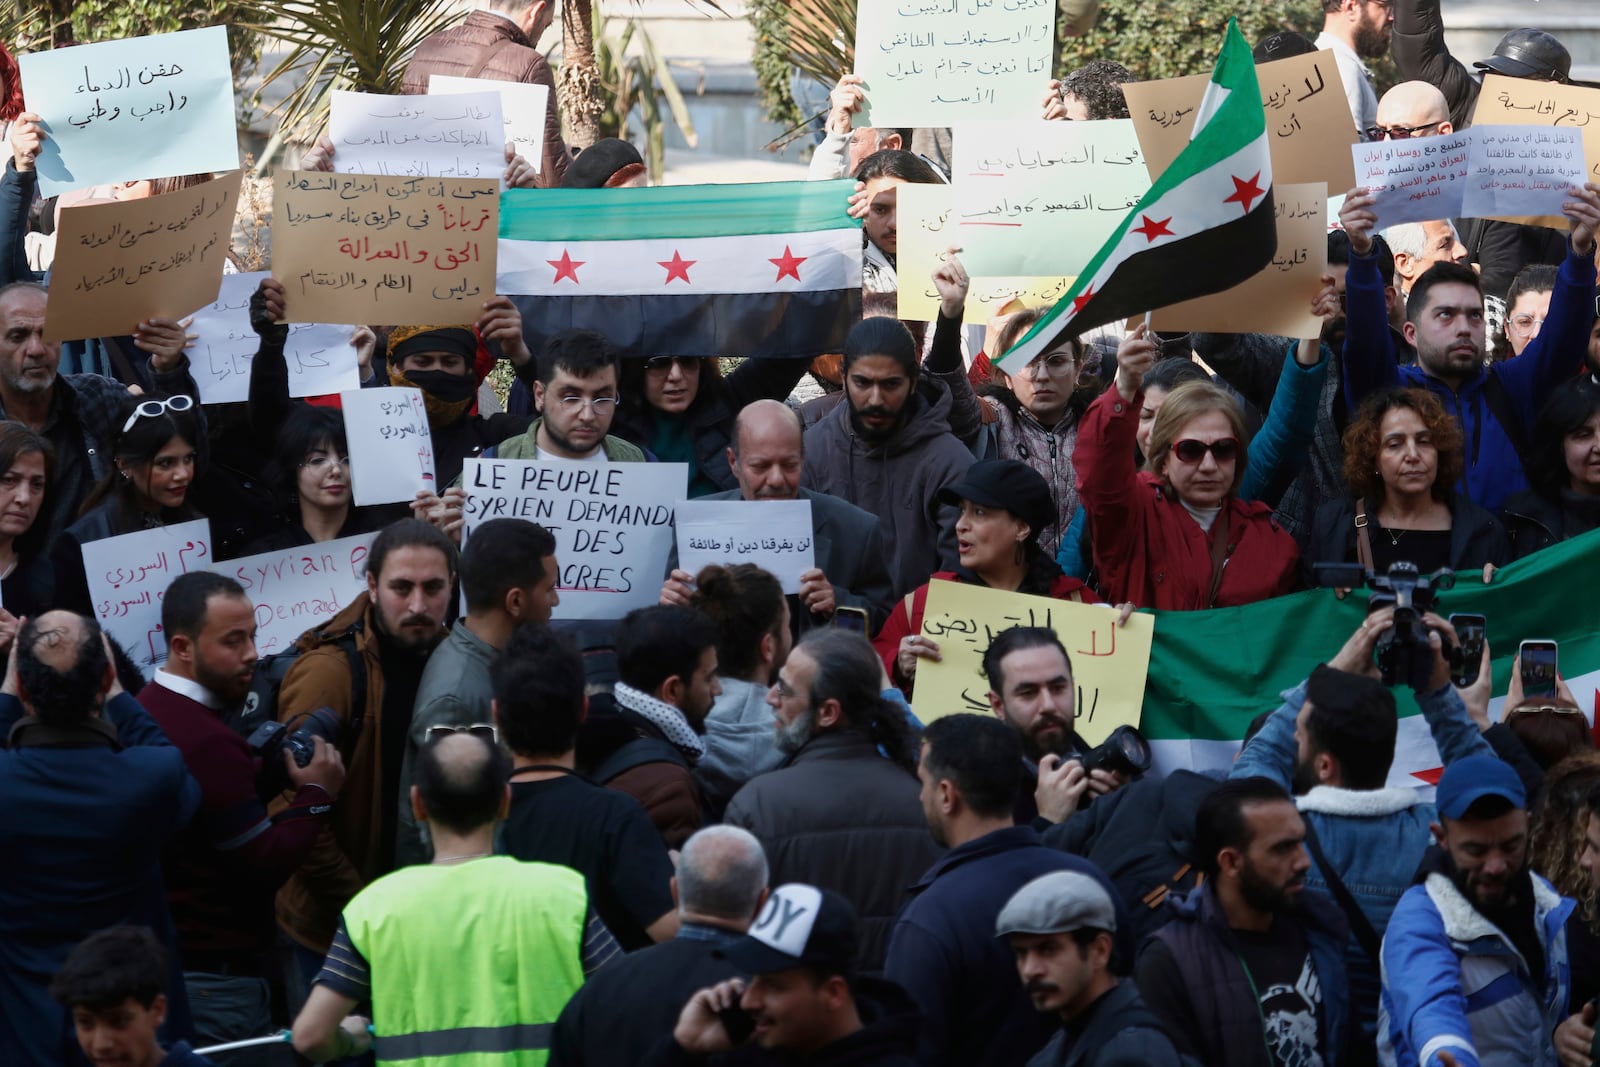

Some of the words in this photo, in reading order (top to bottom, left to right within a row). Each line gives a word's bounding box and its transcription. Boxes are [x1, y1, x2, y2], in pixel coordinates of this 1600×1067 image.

[138, 62, 184, 86] حقن
[977, 58, 1017, 76] ندين
[1027, 55, 1050, 74] كما
[75, 65, 131, 95] الدماء
[1297, 63, 1325, 102] لا
[130, 90, 188, 122] واجب
[931, 87, 995, 105] الأسد
[67, 97, 121, 130] وطني
[1149, 105, 1194, 129] سورية
[1277, 113, 1302, 138] أن
[427, 181, 445, 197] أن
[286, 202, 333, 227] سوريا
[364, 204, 401, 230] طريق
[406, 209, 430, 230] في
[434, 241, 480, 270] الحق
[432, 277, 480, 300] وليس
[473, 463, 507, 490] LE
[520, 466, 624, 497] PEUPLE
[465, 494, 554, 520] SYRIEN
[573, 528, 627, 555] DES
[689, 537, 721, 550] طائفة
[723, 537, 734, 553] أو
[738, 542, 758, 554] دين
[761, 537, 794, 554] يفرقنا
[797, 537, 811, 552] لن
[105, 551, 168, 588] السوري
[97, 591, 151, 617] السوري
[1077, 622, 1117, 656] لا
